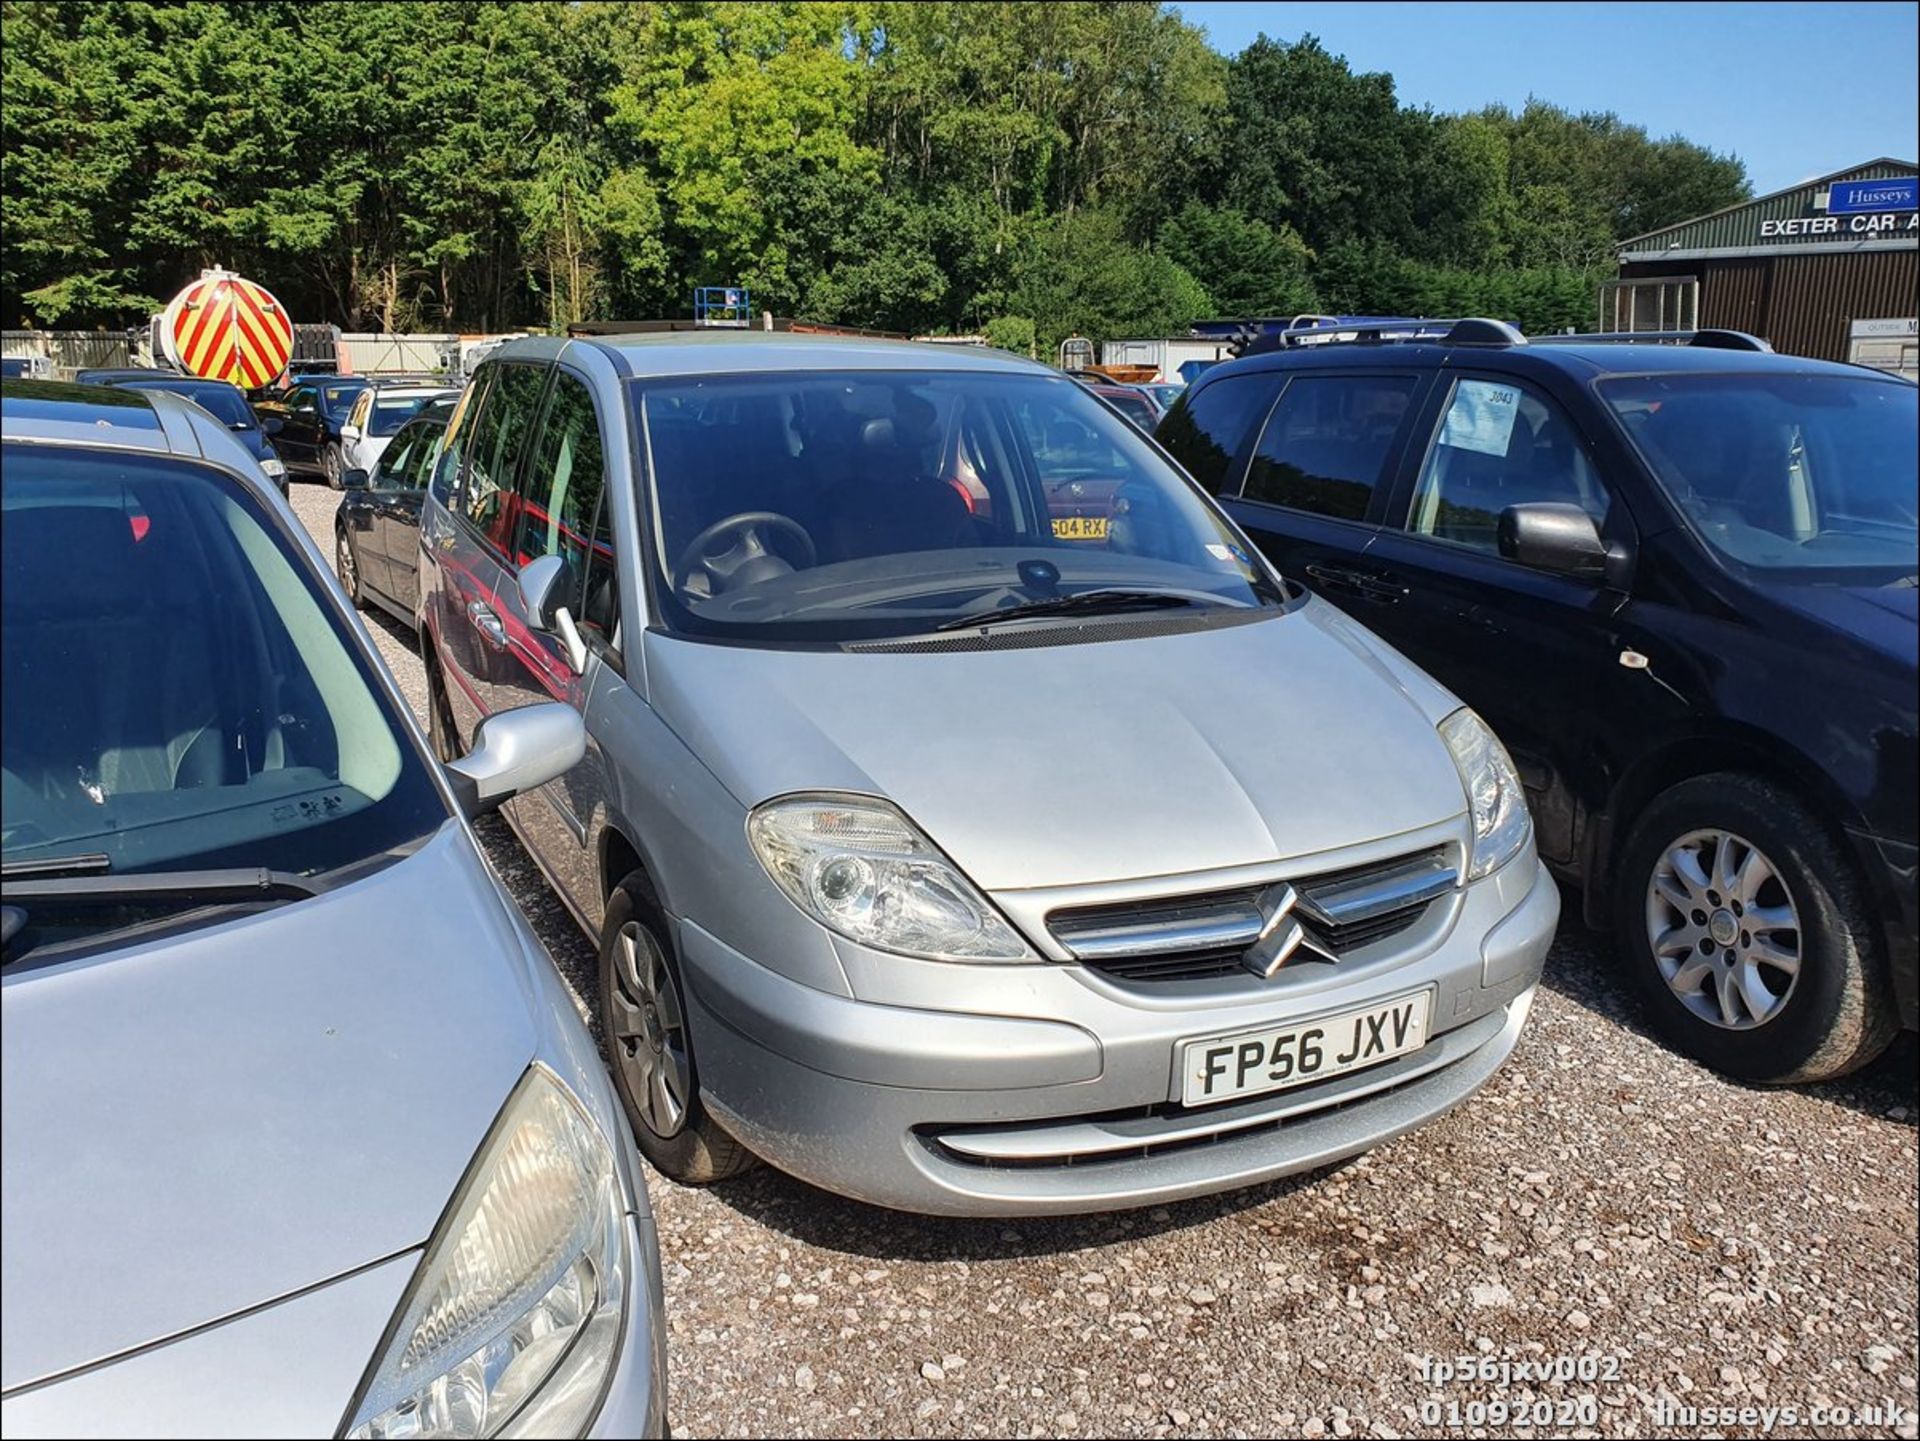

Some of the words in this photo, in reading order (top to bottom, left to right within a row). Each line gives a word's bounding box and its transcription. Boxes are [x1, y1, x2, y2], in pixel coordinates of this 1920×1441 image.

[1848, 189, 1911, 204] Husseys
[1761, 217, 1838, 236] EXETER
[1850, 214, 1896, 232] CAR
[1204, 1028, 1323, 1094] FP56
[1336, 1003, 1413, 1064] JXV
